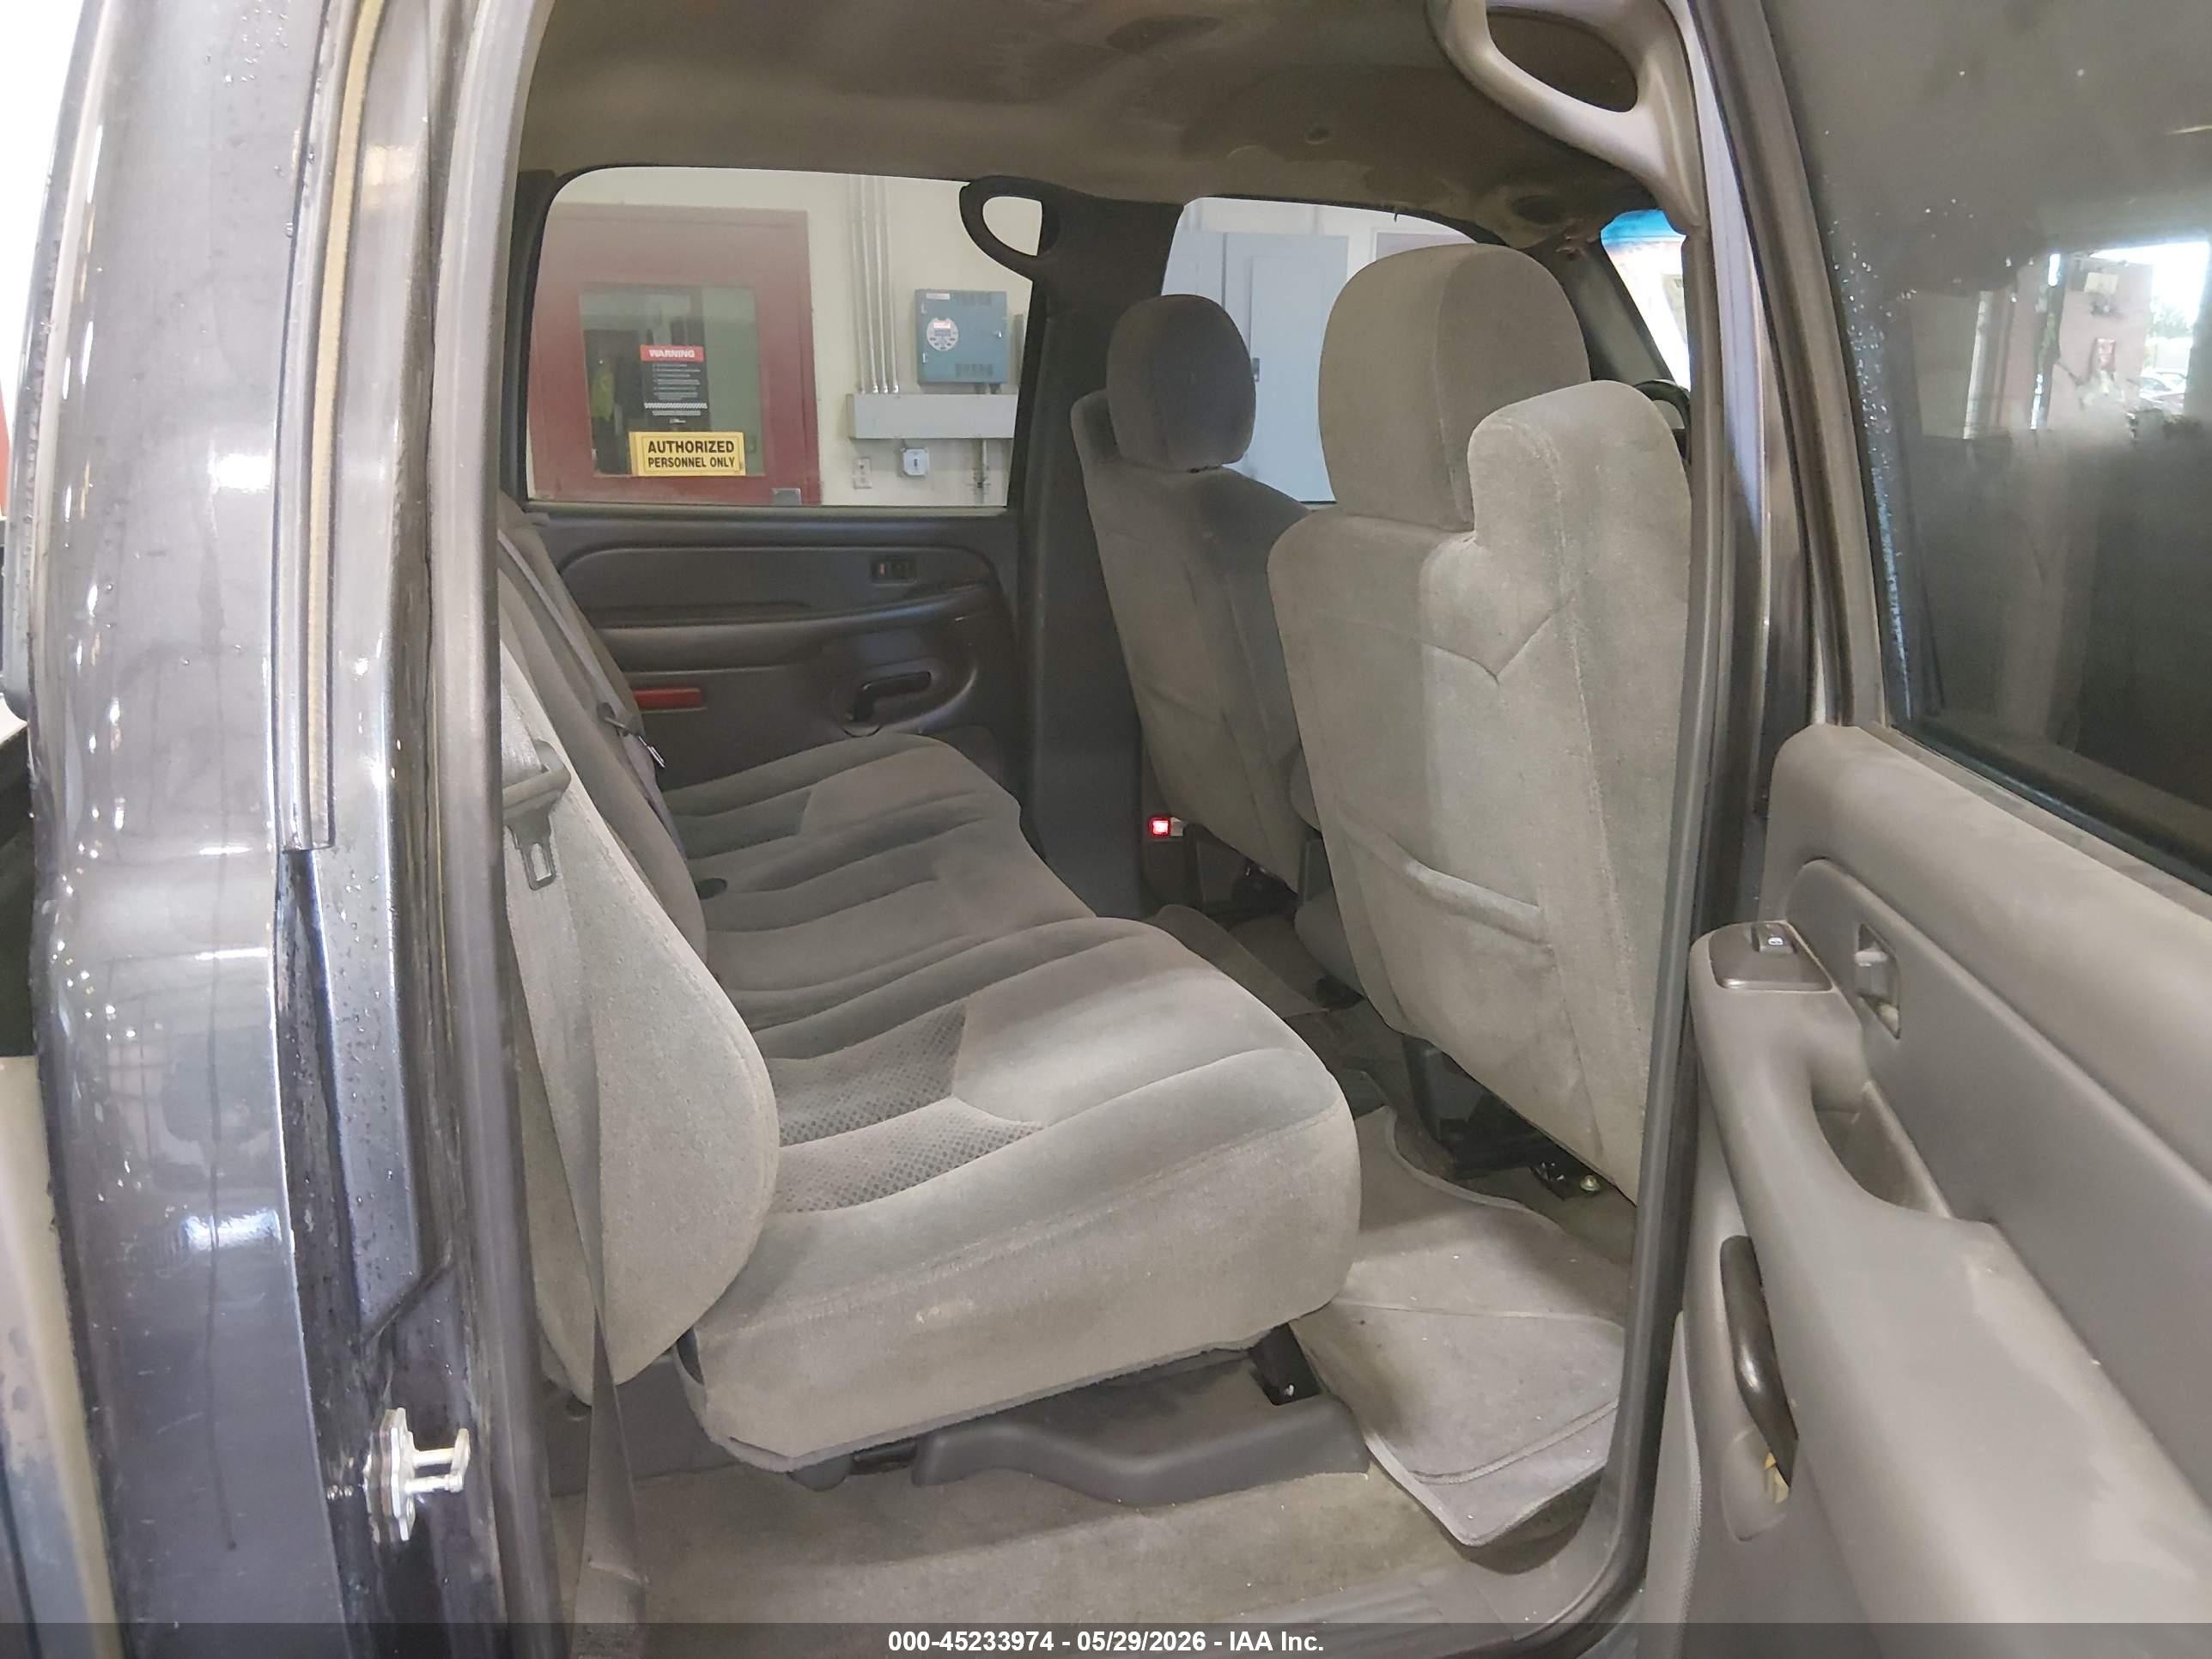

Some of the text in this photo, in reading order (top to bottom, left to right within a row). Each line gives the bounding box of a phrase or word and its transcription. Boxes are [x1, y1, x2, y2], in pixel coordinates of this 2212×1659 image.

[648, 349, 696, 358] WARNING
[647, 440, 735, 453] AUTHORIZED
[647, 456, 736, 468] PERSONNEL ONLY
